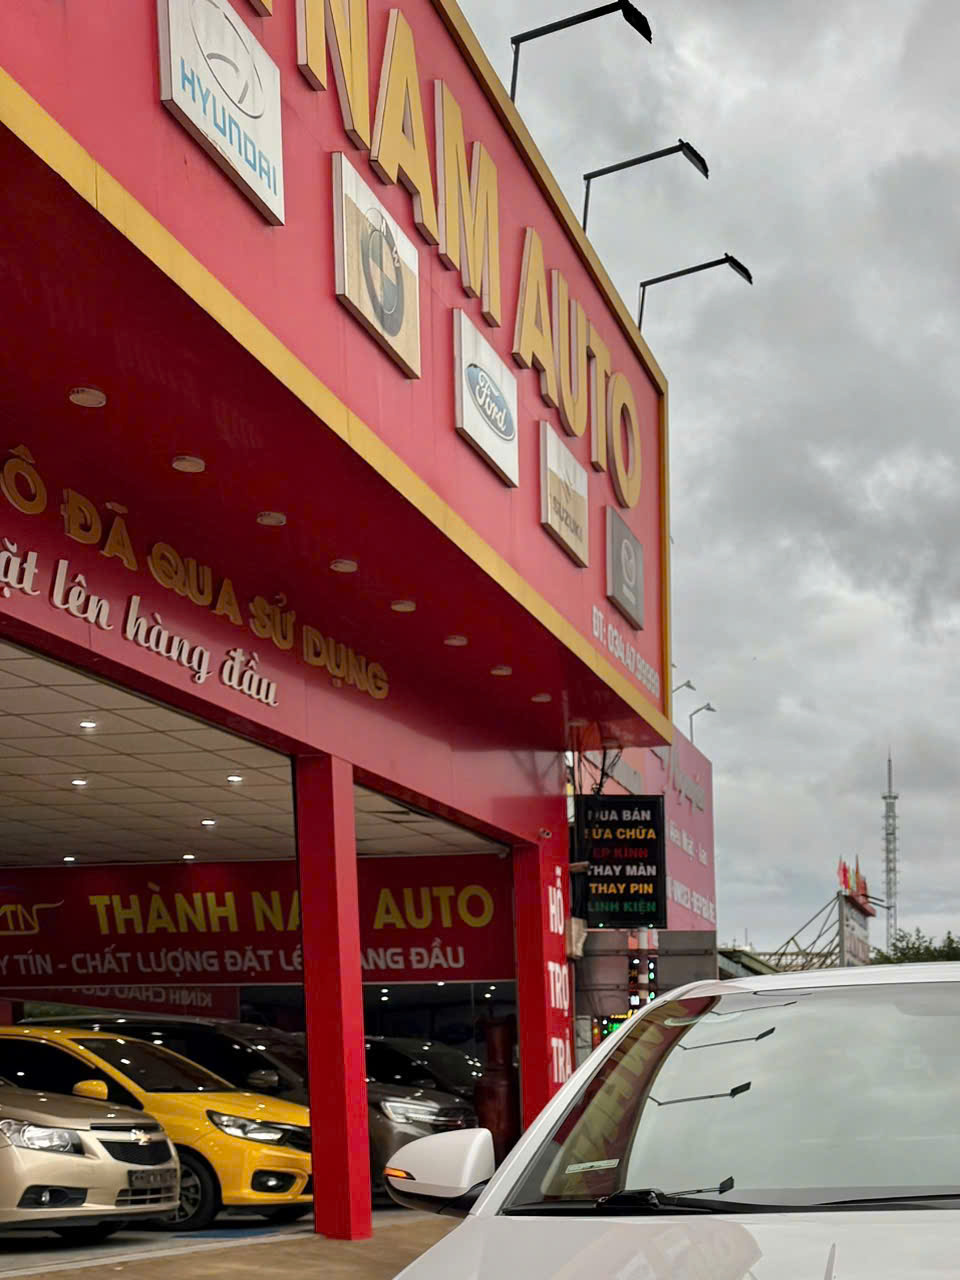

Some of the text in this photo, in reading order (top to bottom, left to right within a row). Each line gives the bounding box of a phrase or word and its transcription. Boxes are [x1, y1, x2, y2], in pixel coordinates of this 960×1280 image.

[179, 55, 279, 197] HYUNDAI
[512, 226, 643, 510] AUTO
[474, 370, 508, 433] Ford
[60, 487, 139, 571] ĐÃ
[147, 541, 243, 626] QUA
[249, 592, 296, 650] SỬ
[303, 624, 390, 700] DỤNG
[52, 558, 114, 630] lên
[125, 595, 212, 684] hàng
[222, 647, 279, 707] đầu
[616, 825, 657, 840] CHỮA
[622, 807, 652, 821] BÁN
[89, 881, 239, 935] THÀNH
[373, 884, 495, 930] AUTO
[589, 882, 654, 895] THAY PIN
[13, 948, 53, 976] TÍN
[71, 943, 131, 975] CHẤT
[137, 948, 218, 978] LƯỢNG
[224, 946, 274, 977] ĐẶT
[409, 936, 466, 970] ĐẦU
[548, 960, 570, 1018] TRỢ
